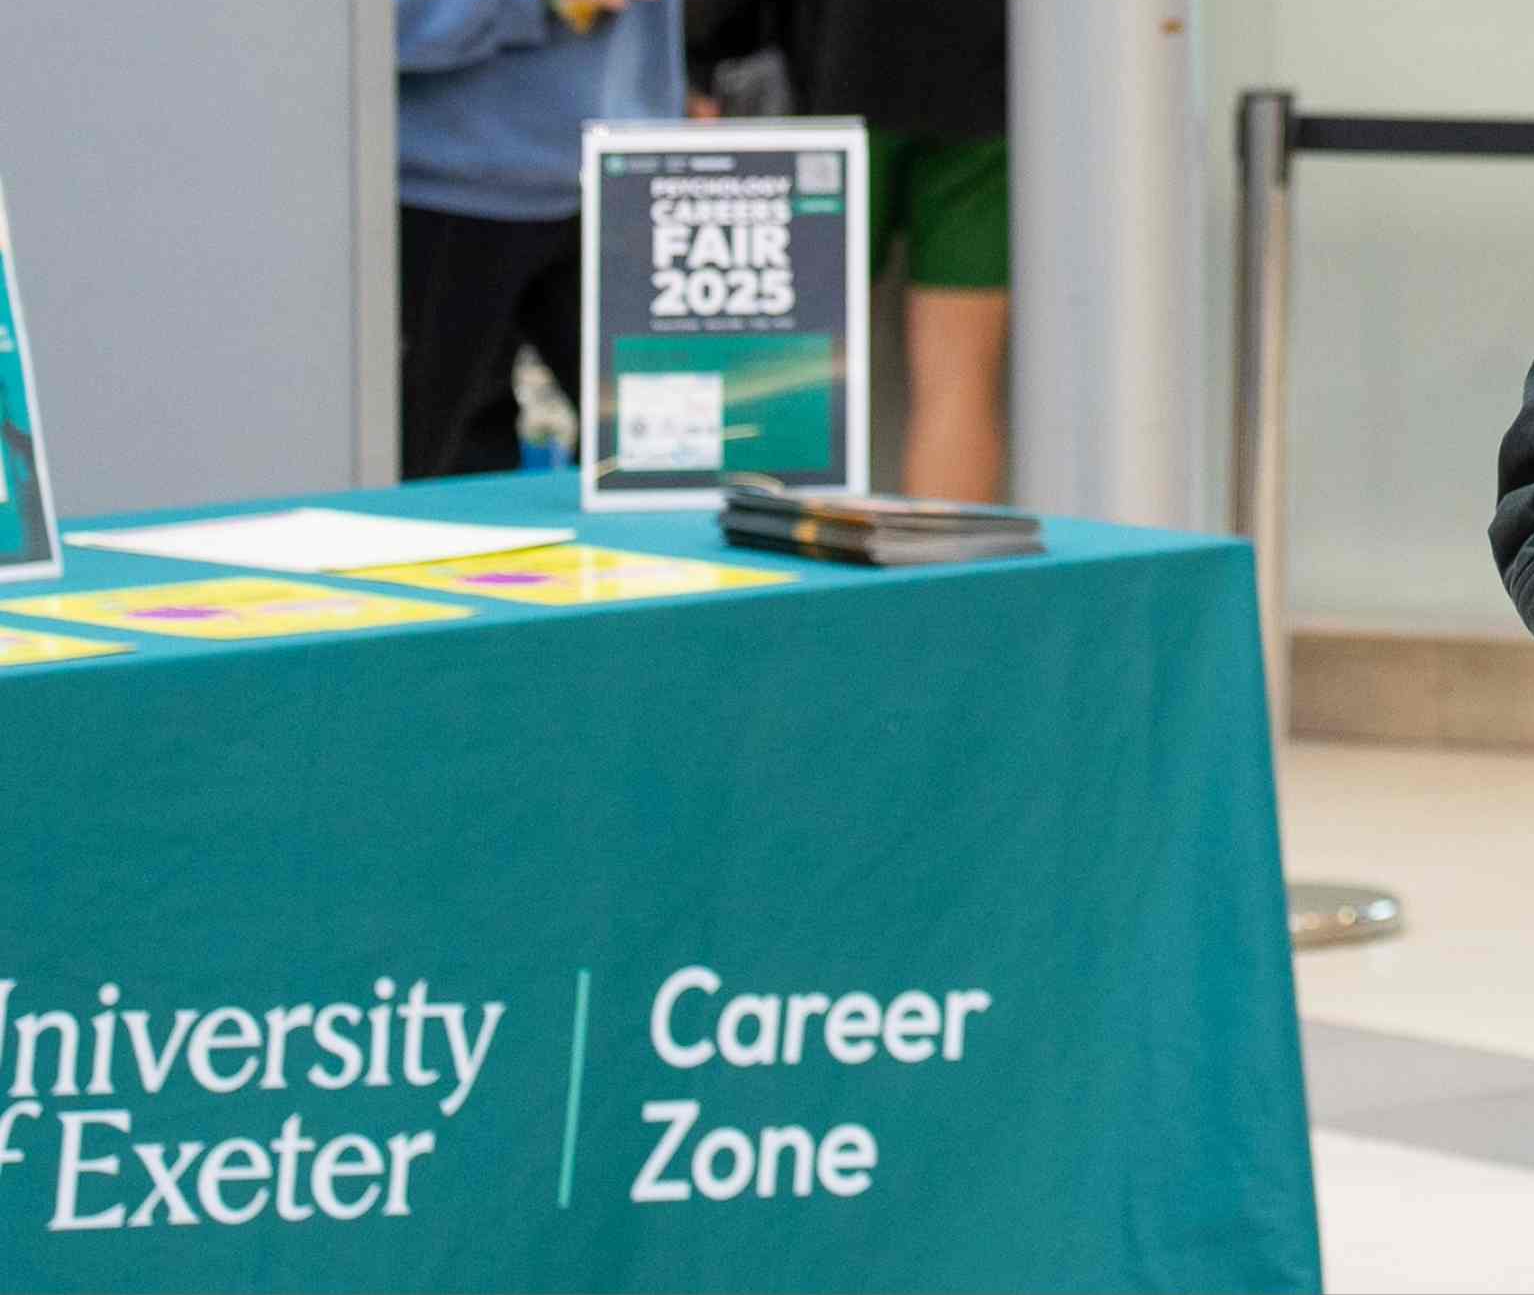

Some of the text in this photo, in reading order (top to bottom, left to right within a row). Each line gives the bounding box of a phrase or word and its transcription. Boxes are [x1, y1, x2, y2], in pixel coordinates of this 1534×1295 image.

[650, 197, 793, 225] CAREERS
[651, 224, 790, 270] FAIR
[649, 268, 796, 317] 2025
[0, 976, 506, 1117] niversity
[649, 964, 992, 1069] Career
[45, 1109, 437, 1233] Exeter
[629, 1098, 879, 1204] Zone
